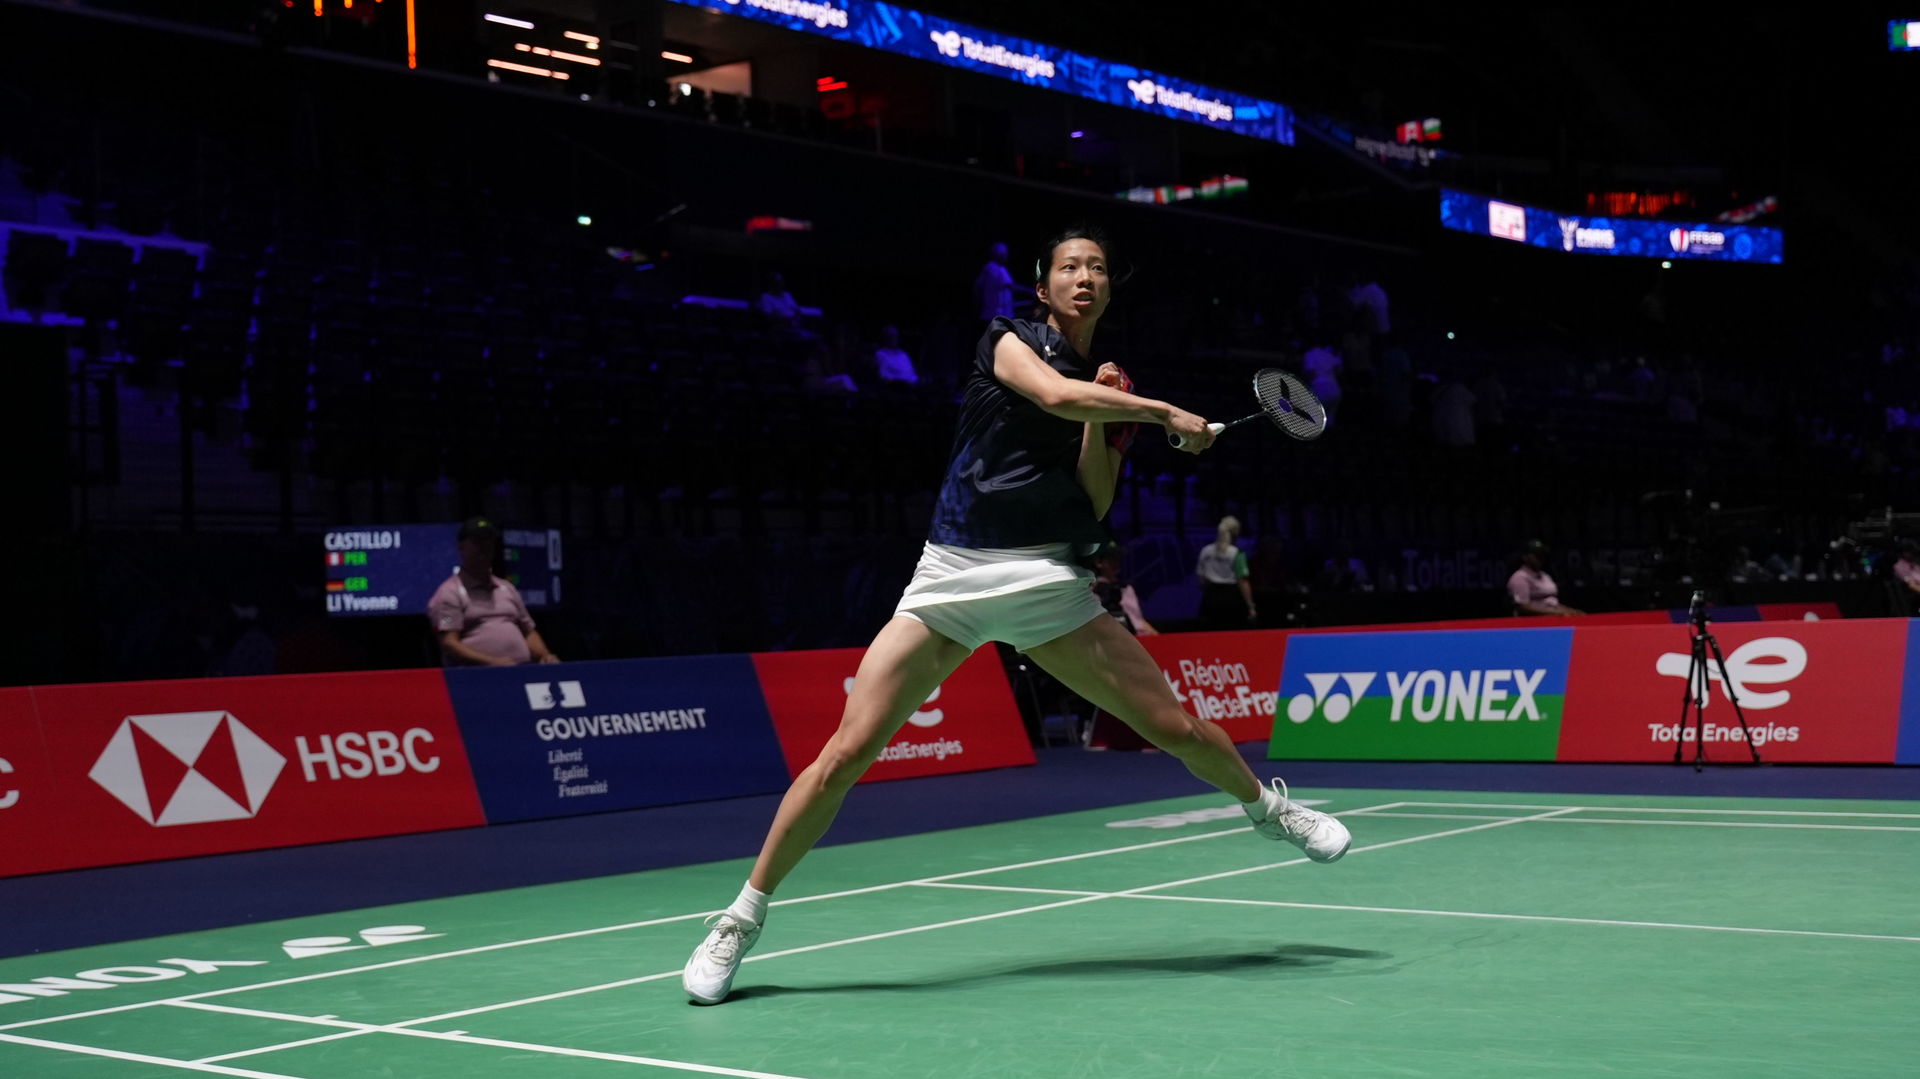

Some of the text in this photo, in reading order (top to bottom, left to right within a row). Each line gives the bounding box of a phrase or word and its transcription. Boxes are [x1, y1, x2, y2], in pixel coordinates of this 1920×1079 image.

[961, 36, 1055, 78] TotalEnergies
[1156, 85, 1233, 121] TotalEnergies
[324, 531, 393, 550] CASTILLO
[344, 551, 367, 566] PER
[344, 577, 368, 592] GER
[342, 594, 399, 611] Yvonne
[1179, 658, 1250, 692] Région
[1386, 668, 1547, 723] YONEX
[535, 708, 706, 741] GOUVERNEMENT
[1648, 722, 1800, 747] TotaEnergies
[295, 727, 440, 782] HSBC
[548, 748, 583, 764] Liberté
[553, 764, 589, 783] Égalité
[558, 780, 608, 798] Fraternité
